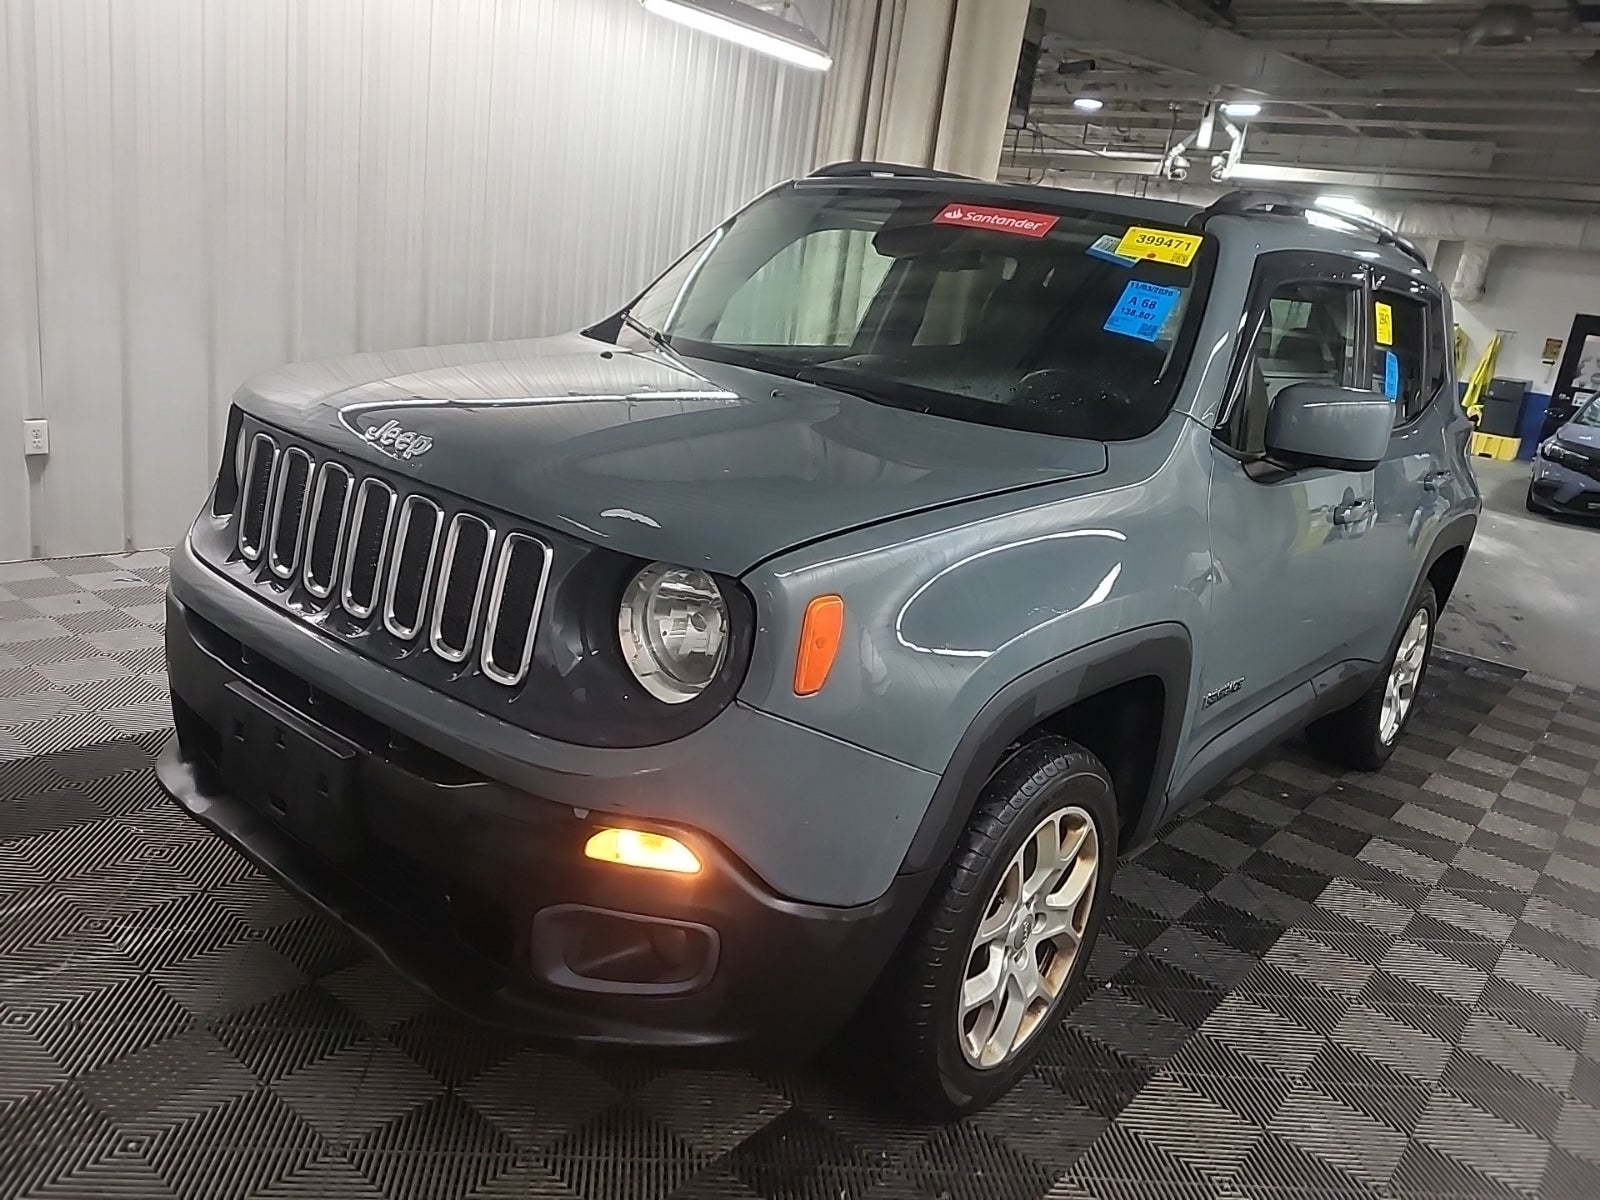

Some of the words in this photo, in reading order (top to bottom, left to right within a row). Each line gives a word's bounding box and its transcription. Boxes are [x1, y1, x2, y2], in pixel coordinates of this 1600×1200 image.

[963, 211, 1043, 230] Santander
[1136, 234, 1192, 251] 399471
[1128, 296, 1138, 306] A
[1141, 299, 1157, 310] 68
[365, 419, 433, 460] Jeep
